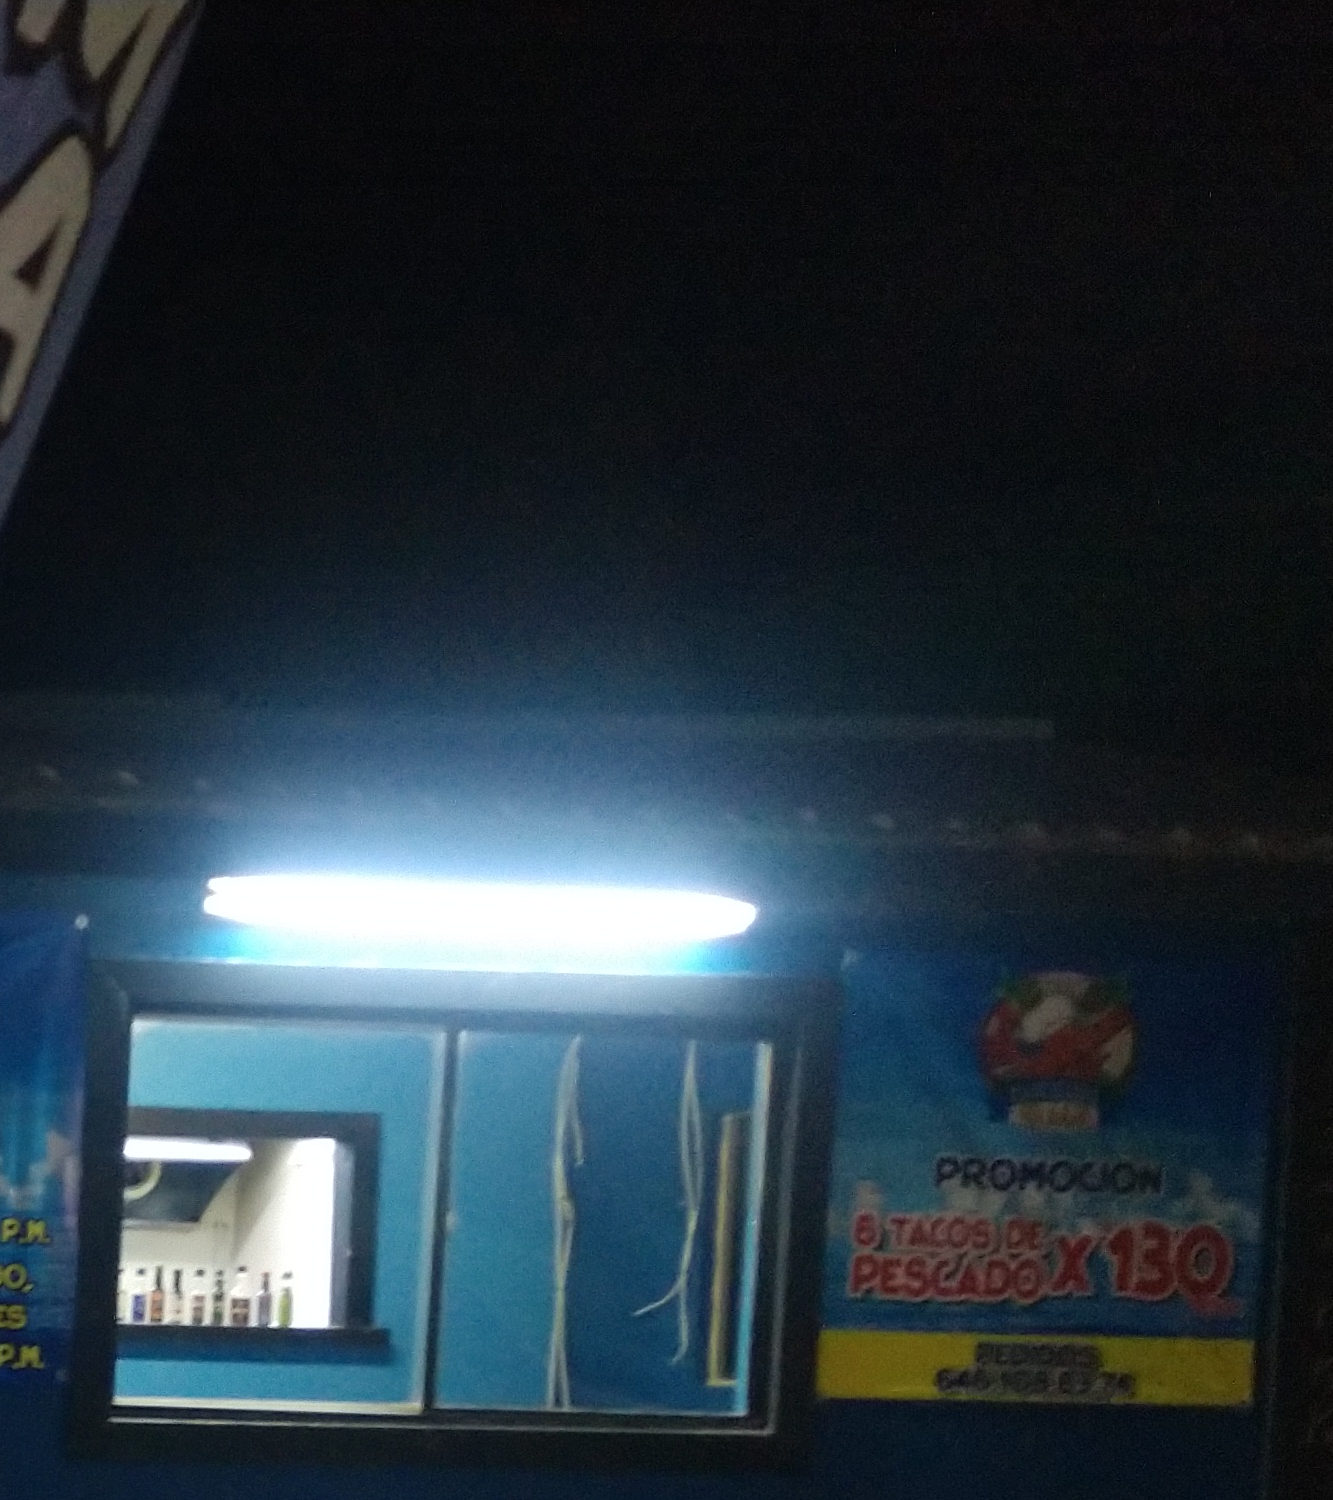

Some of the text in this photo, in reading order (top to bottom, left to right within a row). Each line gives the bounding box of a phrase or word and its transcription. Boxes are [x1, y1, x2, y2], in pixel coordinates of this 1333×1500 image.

[0, 1218, 52, 1244] P.M.
[889, 1216, 994, 1251] TACOS
[1004, 1216, 1045, 1252] DE
[849, 1252, 1045, 1300] PESCADO
